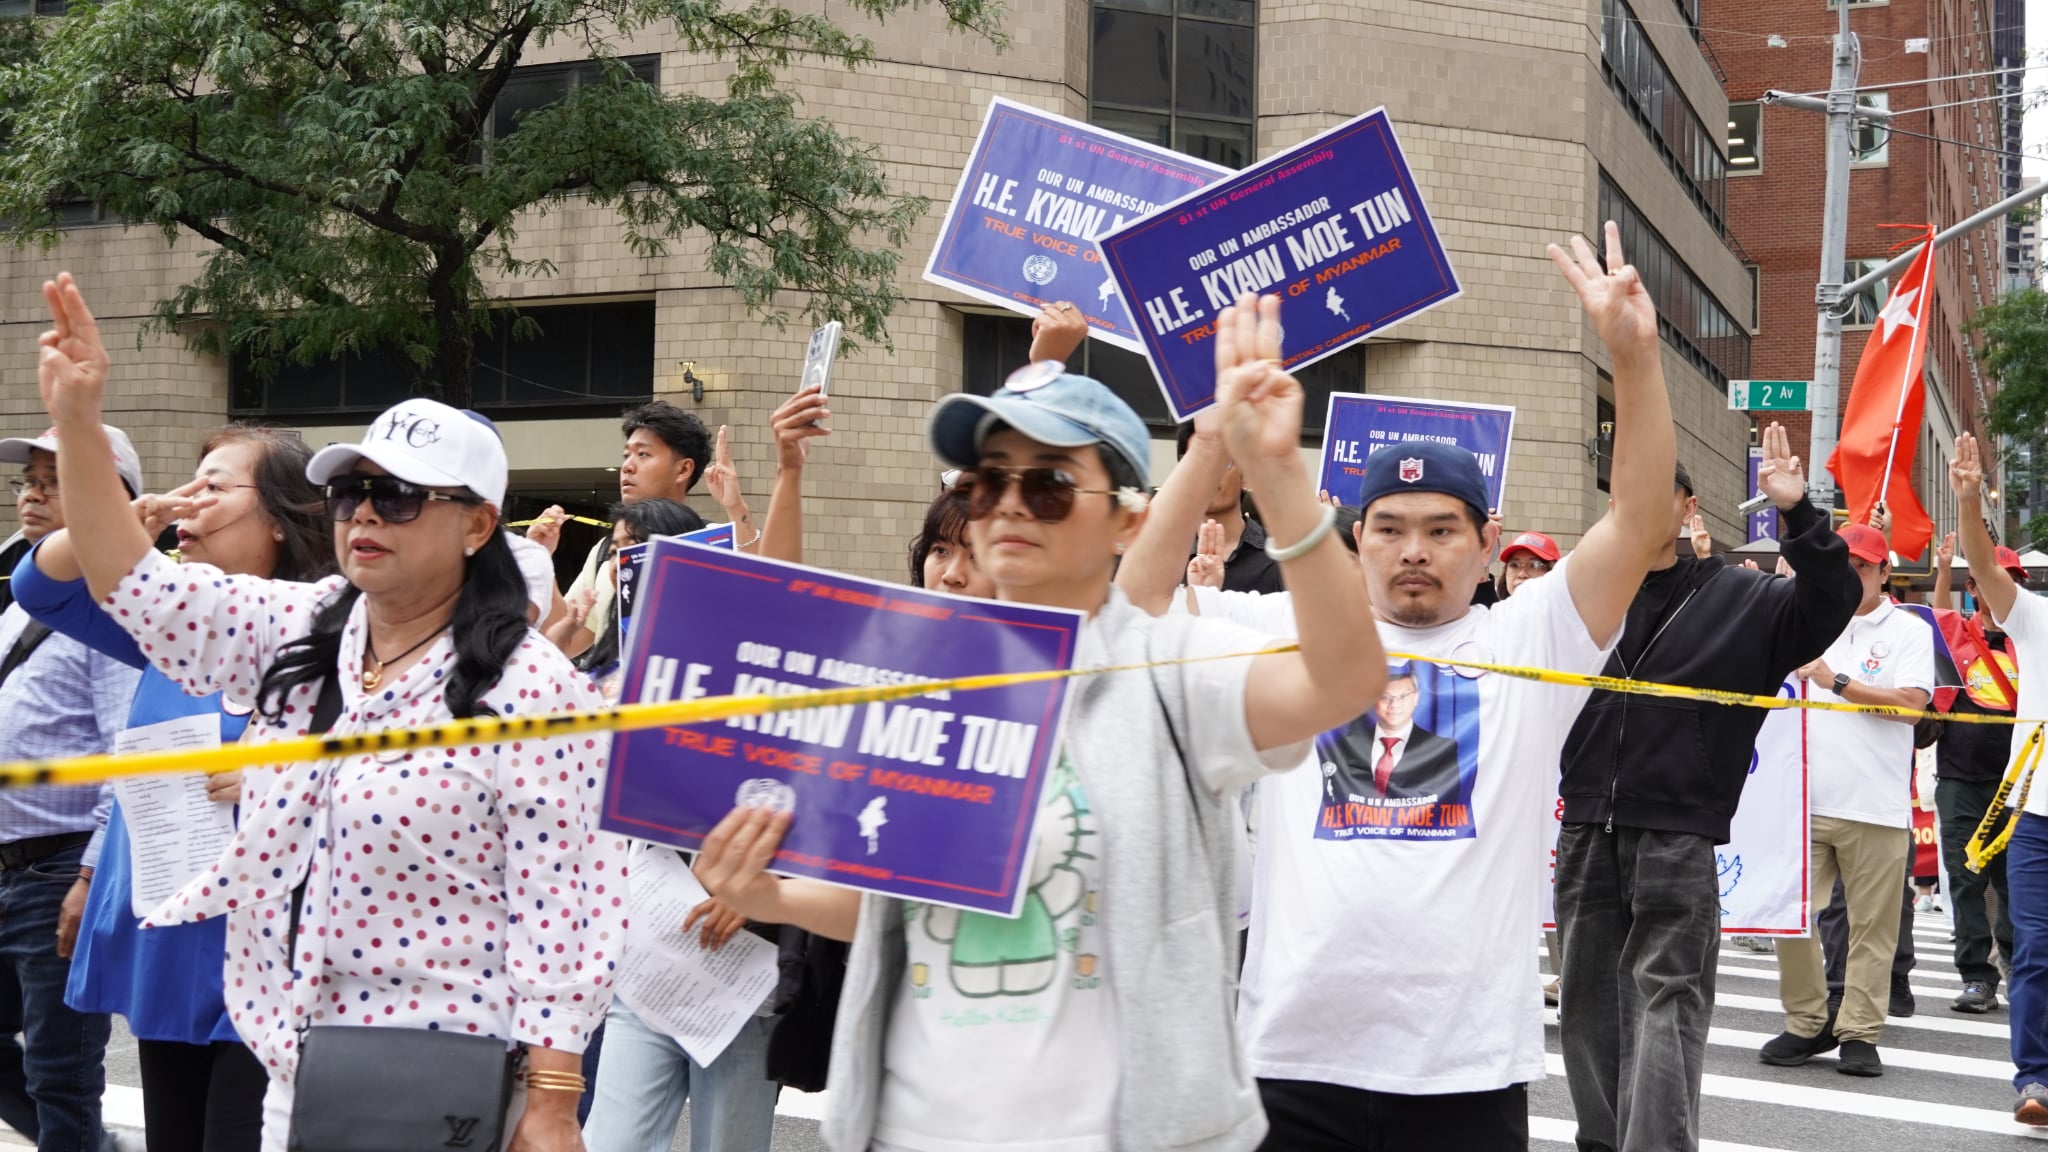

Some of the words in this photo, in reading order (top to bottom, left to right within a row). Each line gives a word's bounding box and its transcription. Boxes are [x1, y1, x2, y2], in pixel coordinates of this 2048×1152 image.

[1059, 134, 1072, 145] 81
[1075, 140, 1087, 150] st
[1089, 143, 1105, 155] UN
[1107, 149, 1149, 170] General
[1152, 160, 1205, 188] Assembly
[1037, 168, 1063, 188] OUR
[1066, 177, 1085, 195] UN
[1178, 213, 1194, 226] 81
[1195, 205, 1208, 218] st
[1210, 197, 1228, 213] UN
[1229, 174, 1275, 203] General
[1277, 148, 1335, 182] Assembly
[973, 171, 1019, 217] H.E.
[1024, 188, 1106, 242] KYAW
[984, 216, 1025, 240] TRUE
[1032, 233, 1077, 257] VOICE
[1188, 248, 1218, 272] OUR
[1218, 238, 1240, 258] UN
[1242, 196, 1331, 248] AMBASSADOR
[1144, 285, 1205, 337] H.E.
[1200, 243, 1287, 311] KYAW
[1285, 212, 1355, 273] MOE
[1349, 186, 1413, 241] TUN
[1180, 320, 1219, 346] TRU
[1287, 277, 1312, 298] OF
[1315, 237, 1403, 286] MYANMAR
[1396, 406, 1408, 415] UN
[1409, 407, 1438, 418] General
[1761, 385, 1772, 406] 2
[1333, 439, 1362, 464] H.E.
[1369, 429, 1386, 440] OUR
[1388, 431, 1400, 441] UN
[1343, 466, 1367, 477] TRU
[736, 641, 782, 669] OUR
[783, 650, 817, 677] UN
[857, 700, 956, 768] MOE
[956, 713, 1040, 780] TUN
[663, 726, 737, 758] TRUE
[742, 743, 824, 776] VOICE
[828, 760, 868, 783] OF
[868, 768, 995, 805] MYANMAR
[1344, 804, 1395, 829] KYAW
[1397, 804, 1436, 828] MOE
[1440, 804, 1470, 827] TUN
[1349, 793, 1367, 804] OUR
[1384, 794, 1439, 807] AMBASSADOR
[1356, 827, 1387, 836] VOICE
[1390, 827, 1405, 836] OF
[1407, 828, 1457, 838] MYANMAR
